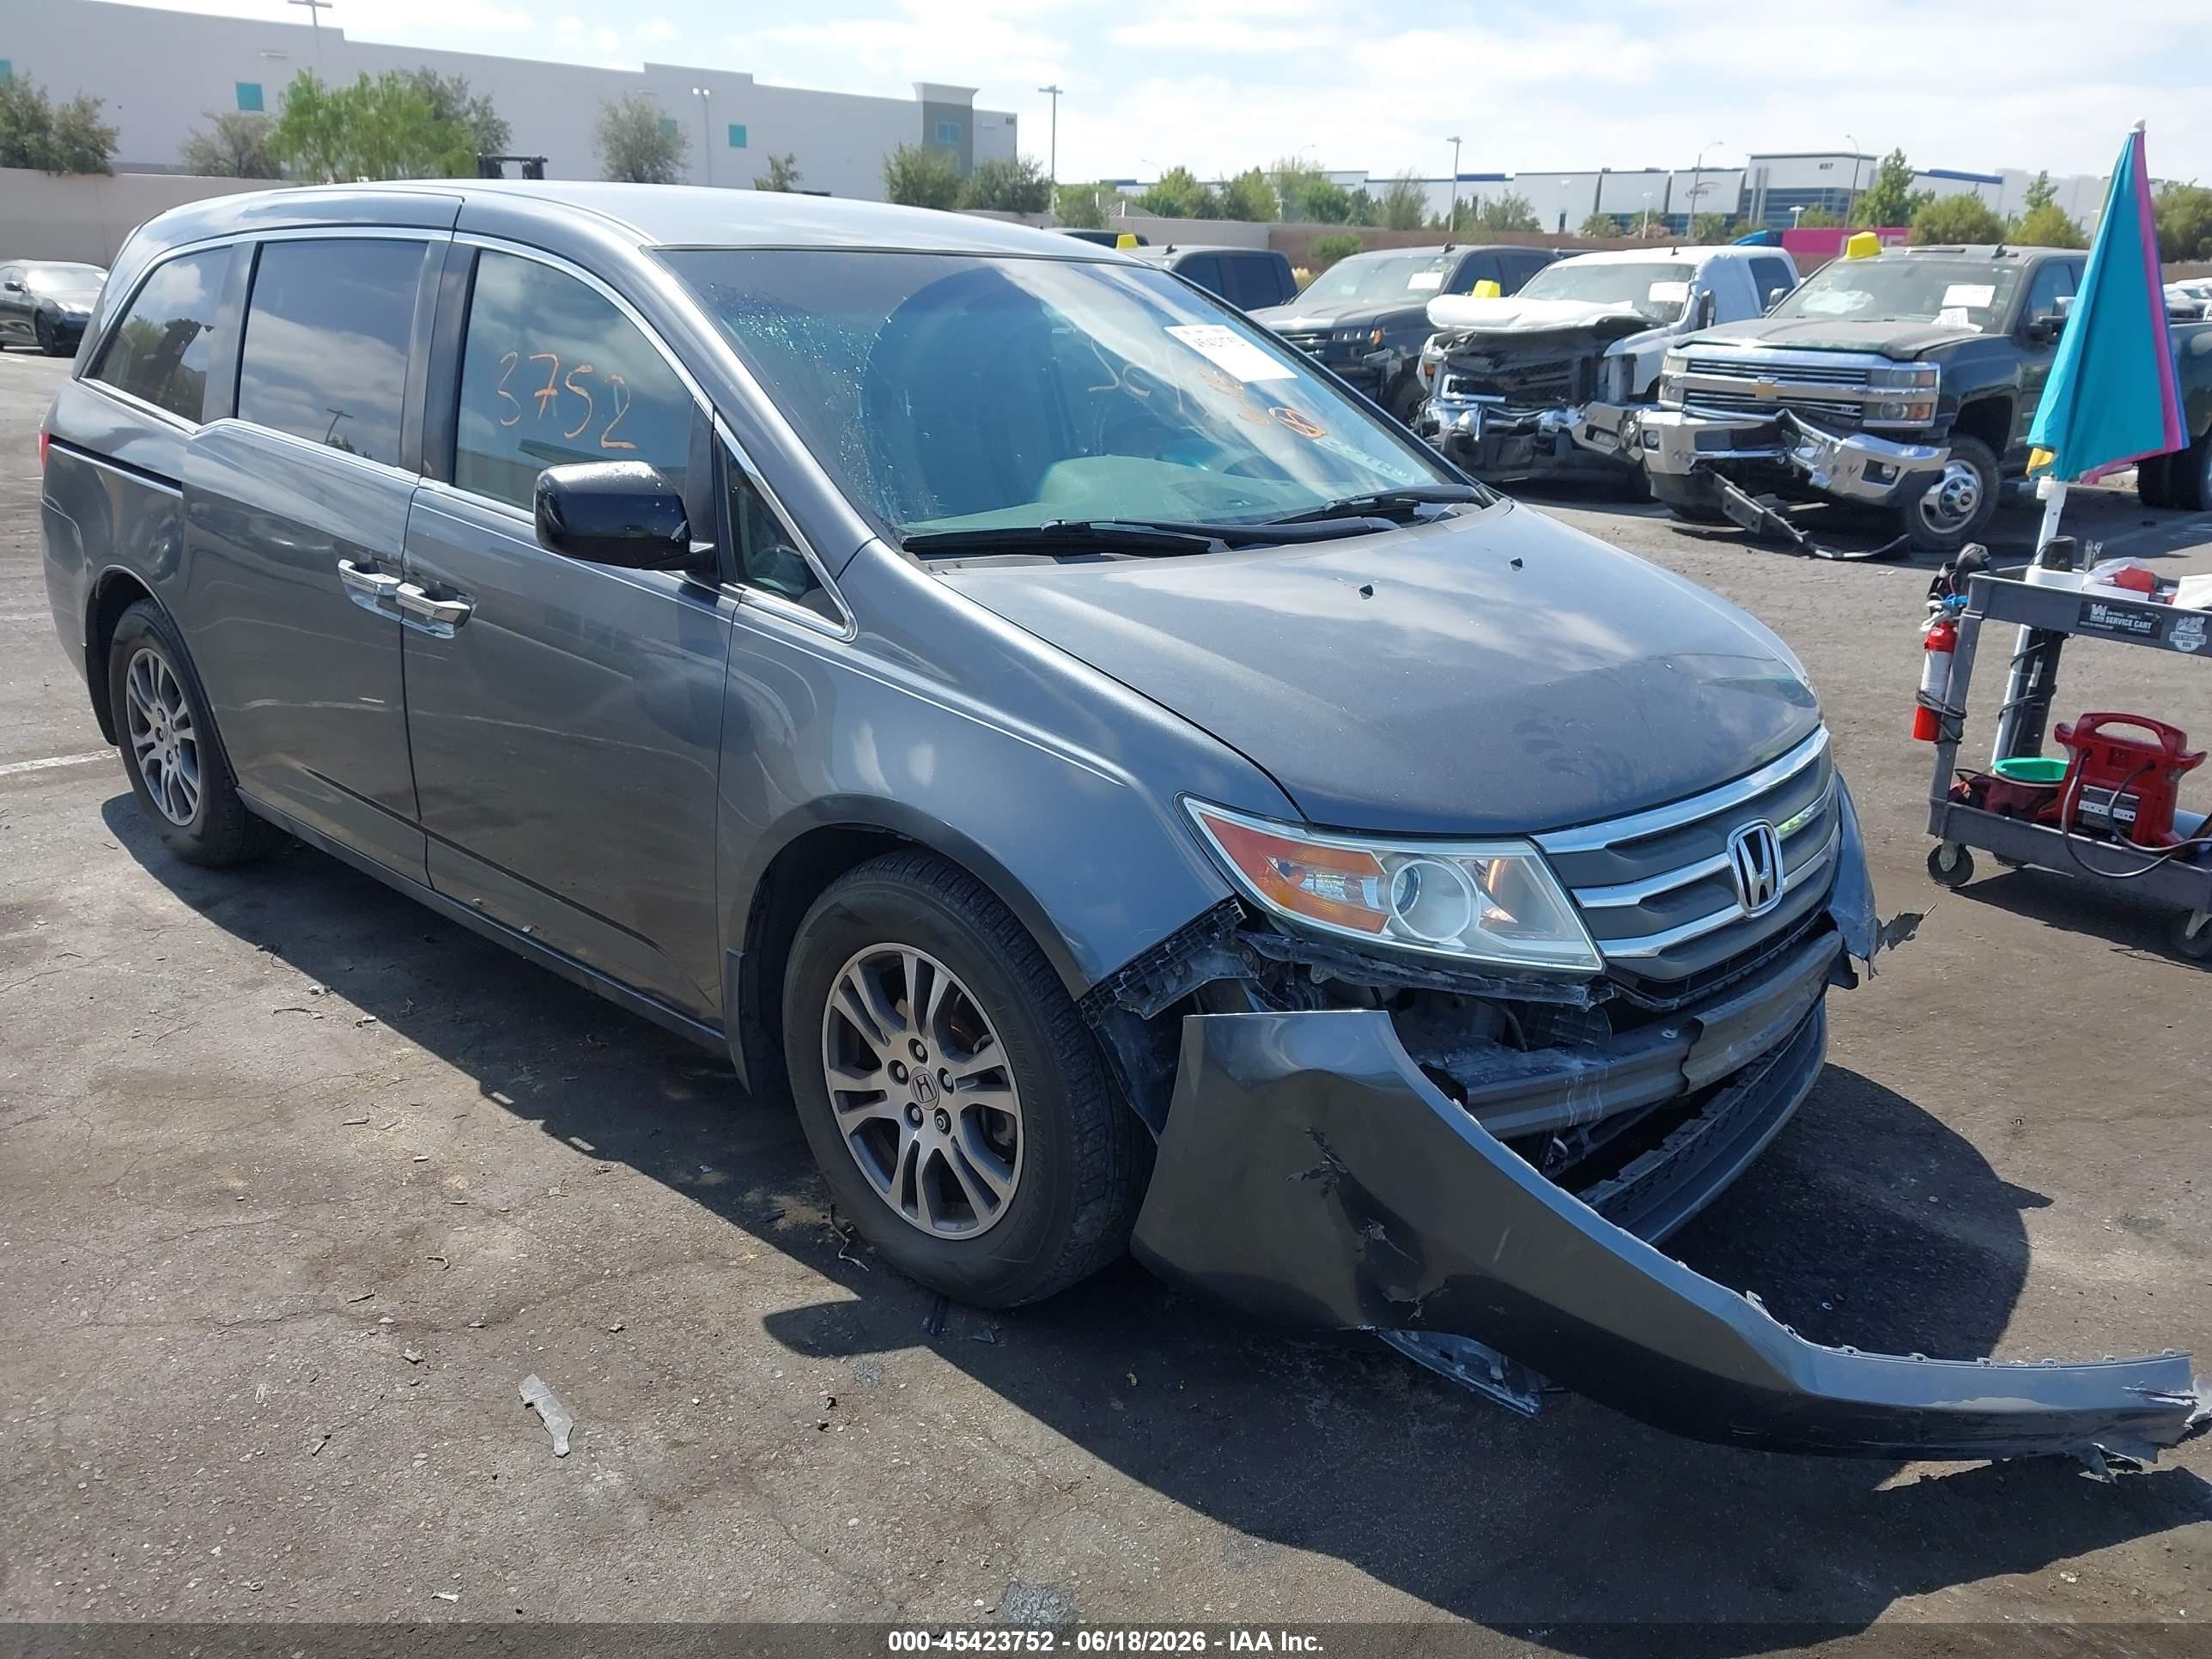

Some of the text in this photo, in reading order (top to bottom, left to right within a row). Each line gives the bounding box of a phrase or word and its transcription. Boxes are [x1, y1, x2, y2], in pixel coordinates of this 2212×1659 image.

[497, 350, 636, 449] 3752
[2106, 617, 2133, 627] SERVICE
[2134, 621, 2152, 629] CART
